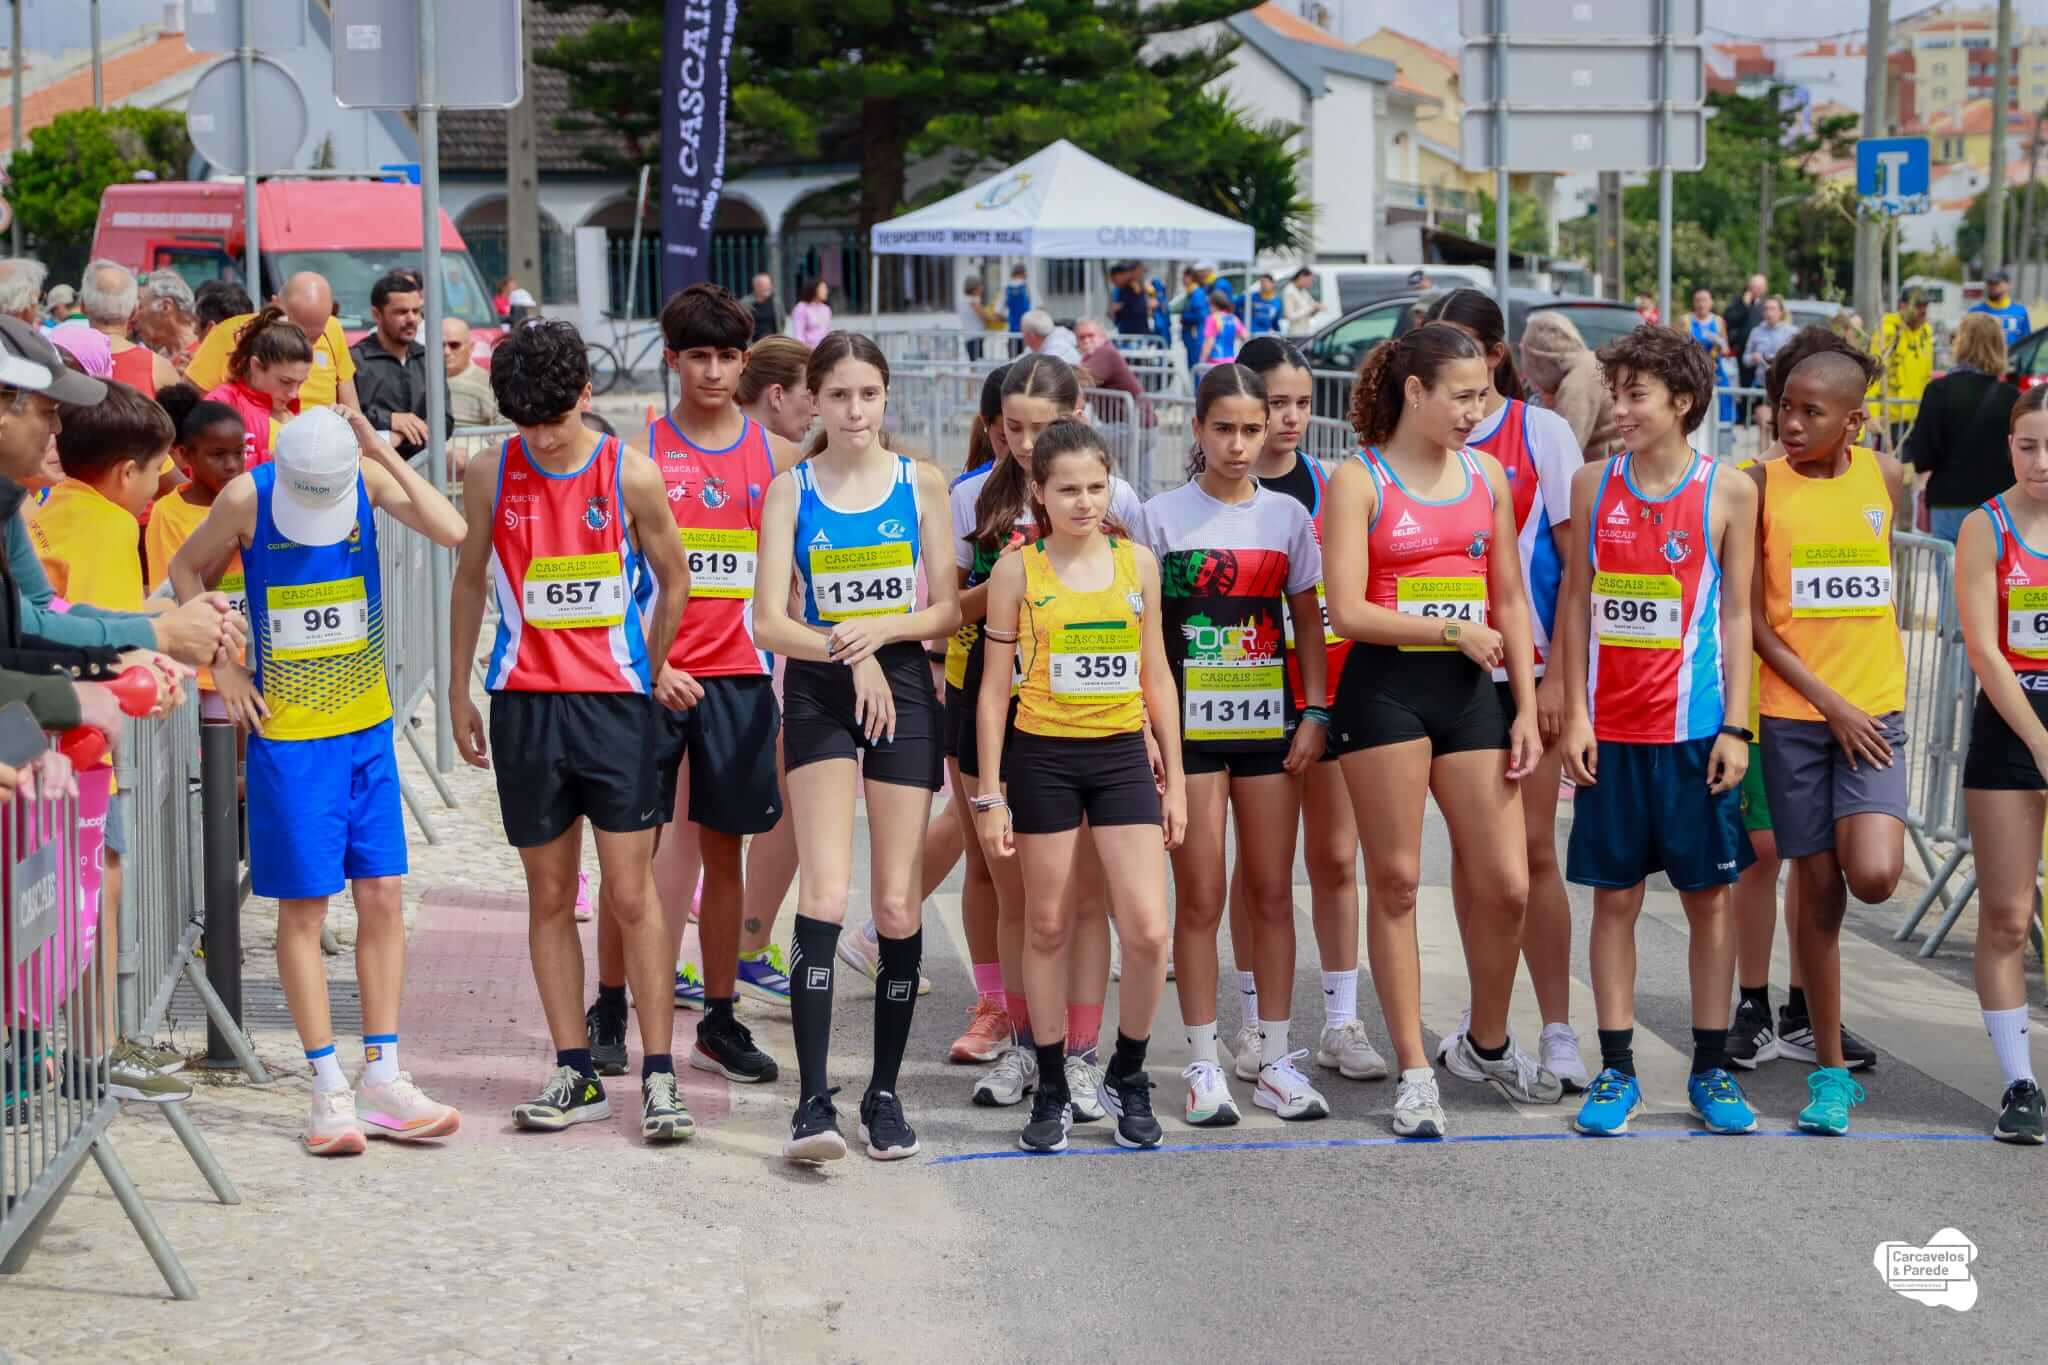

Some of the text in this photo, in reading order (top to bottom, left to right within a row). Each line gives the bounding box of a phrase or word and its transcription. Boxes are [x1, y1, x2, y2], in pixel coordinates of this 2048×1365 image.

[1097, 227, 1191, 247] CASCAIS
[1392, 526, 1421, 537] SELECT
[1598, 528, 1638, 540] CASCAIS
[1390, 536, 1440, 552] CASCAIS
[824, 551, 878, 565] CASCAIS
[1805, 547, 1858, 560] CASCAIS
[535, 561, 587, 573] CASCAIS
[688, 552, 738, 574] 619
[828, 577, 903, 604] 1348
[1411, 582, 1462, 593] CASCAIS
[1598, 577, 1645, 590] CASCAIS
[1807, 576, 1881, 599] 1663
[281, 586, 335, 601] CASCAIS
[546, 581, 602, 605] 657
[303, 606, 341, 632] 96
[1421, 603, 1472, 620] 624
[1603, 599, 1658, 623] 696
[1064, 633, 1116, 646] CASCAIS
[1074, 655, 1127, 679] 359
[1200, 672, 1251, 683] CASCAIS
[1200, 699, 1271, 722] 1314
